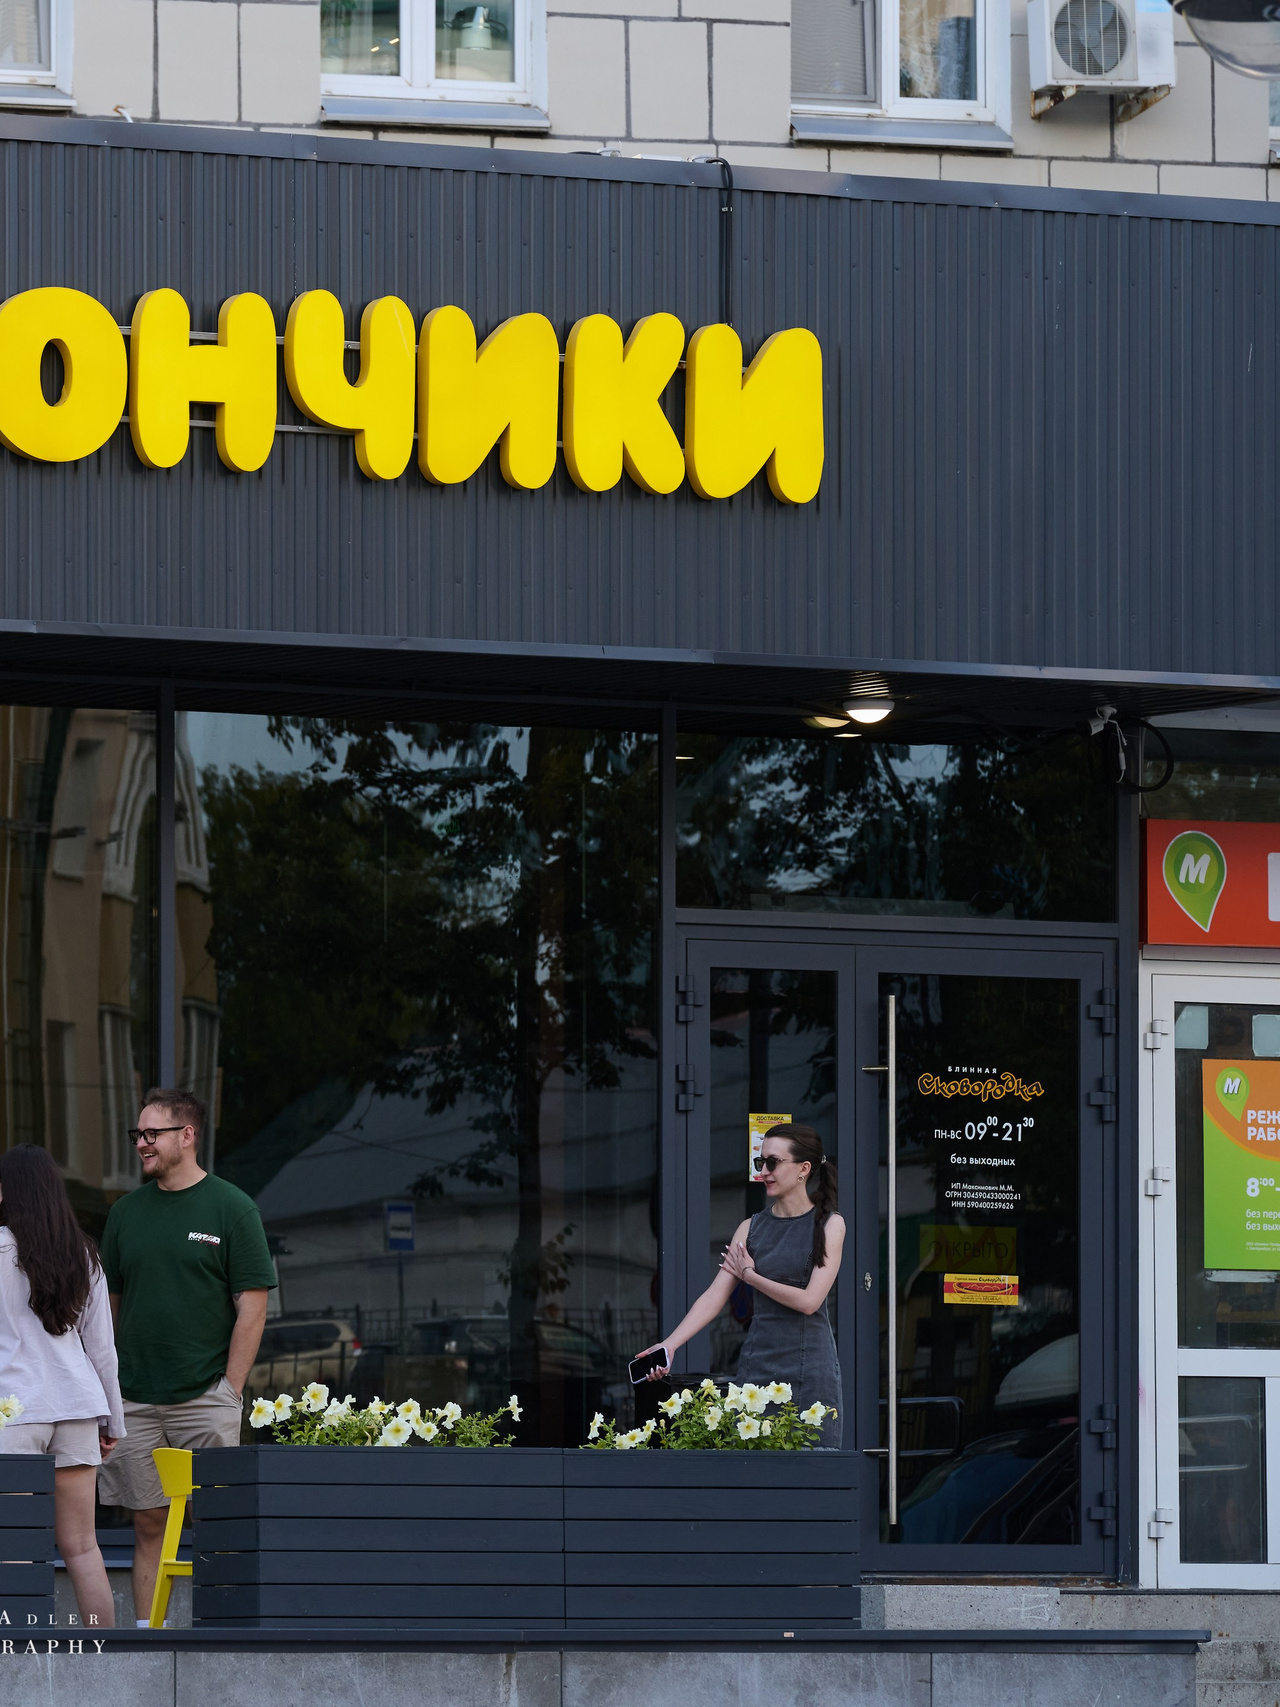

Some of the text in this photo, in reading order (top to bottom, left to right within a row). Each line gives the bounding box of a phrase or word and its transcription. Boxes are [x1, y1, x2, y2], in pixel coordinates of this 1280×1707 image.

[947, 1065, 997, 1074] БЛИННАЯ
[918, 1071, 1044, 1102] Сковородка
[934, 1129, 962, 1140] ПН-ВС
[1247, 1127, 1280, 1141] РАБ
[950, 1153, 1016, 1167] без выходных
[999, 1184, 1014, 1192] М.М.
[945, 1190, 1021, 1200] ОГРН 304590433000241
[951, 1200, 1014, 1210] ИНН 590400259626
[1246, 1208, 1261, 1218] без
[1246, 1221, 1280, 1232] без вых
[929, 1240, 1008, 1258] ОТКРЫТО
